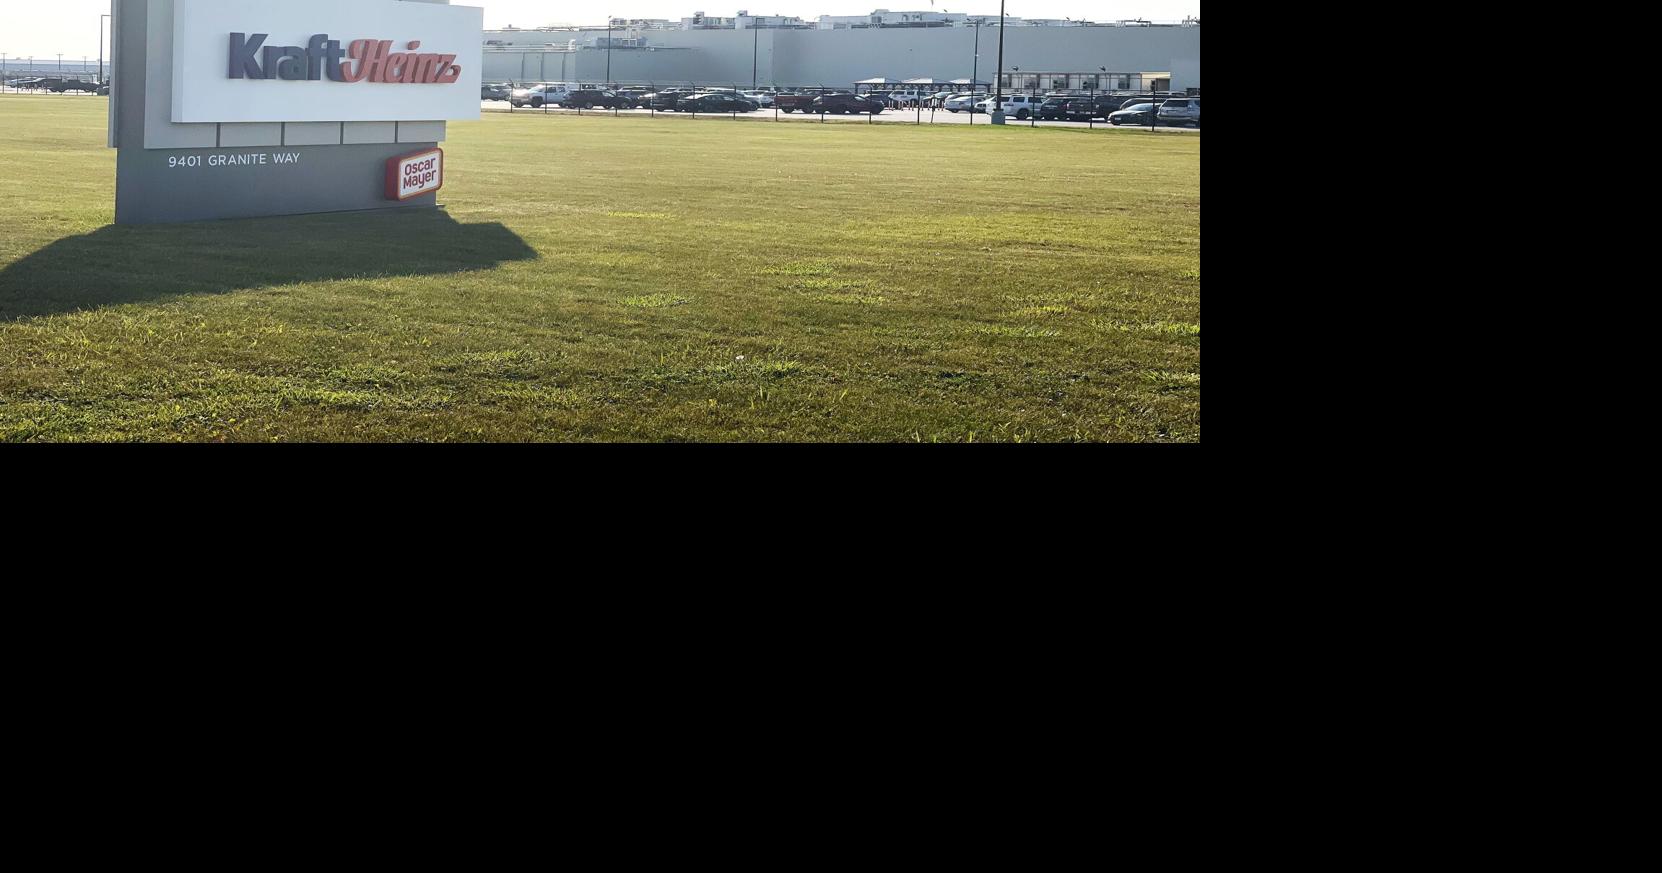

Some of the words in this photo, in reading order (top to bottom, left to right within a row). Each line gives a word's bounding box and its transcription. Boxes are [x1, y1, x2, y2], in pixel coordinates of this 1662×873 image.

[168, 155, 201, 168] 9401
[208, 153, 267, 166] GRANITE
[273, 152, 300, 164] WAY
[404, 158, 436, 176] Oscar
[403, 170, 436, 189] Mayer
